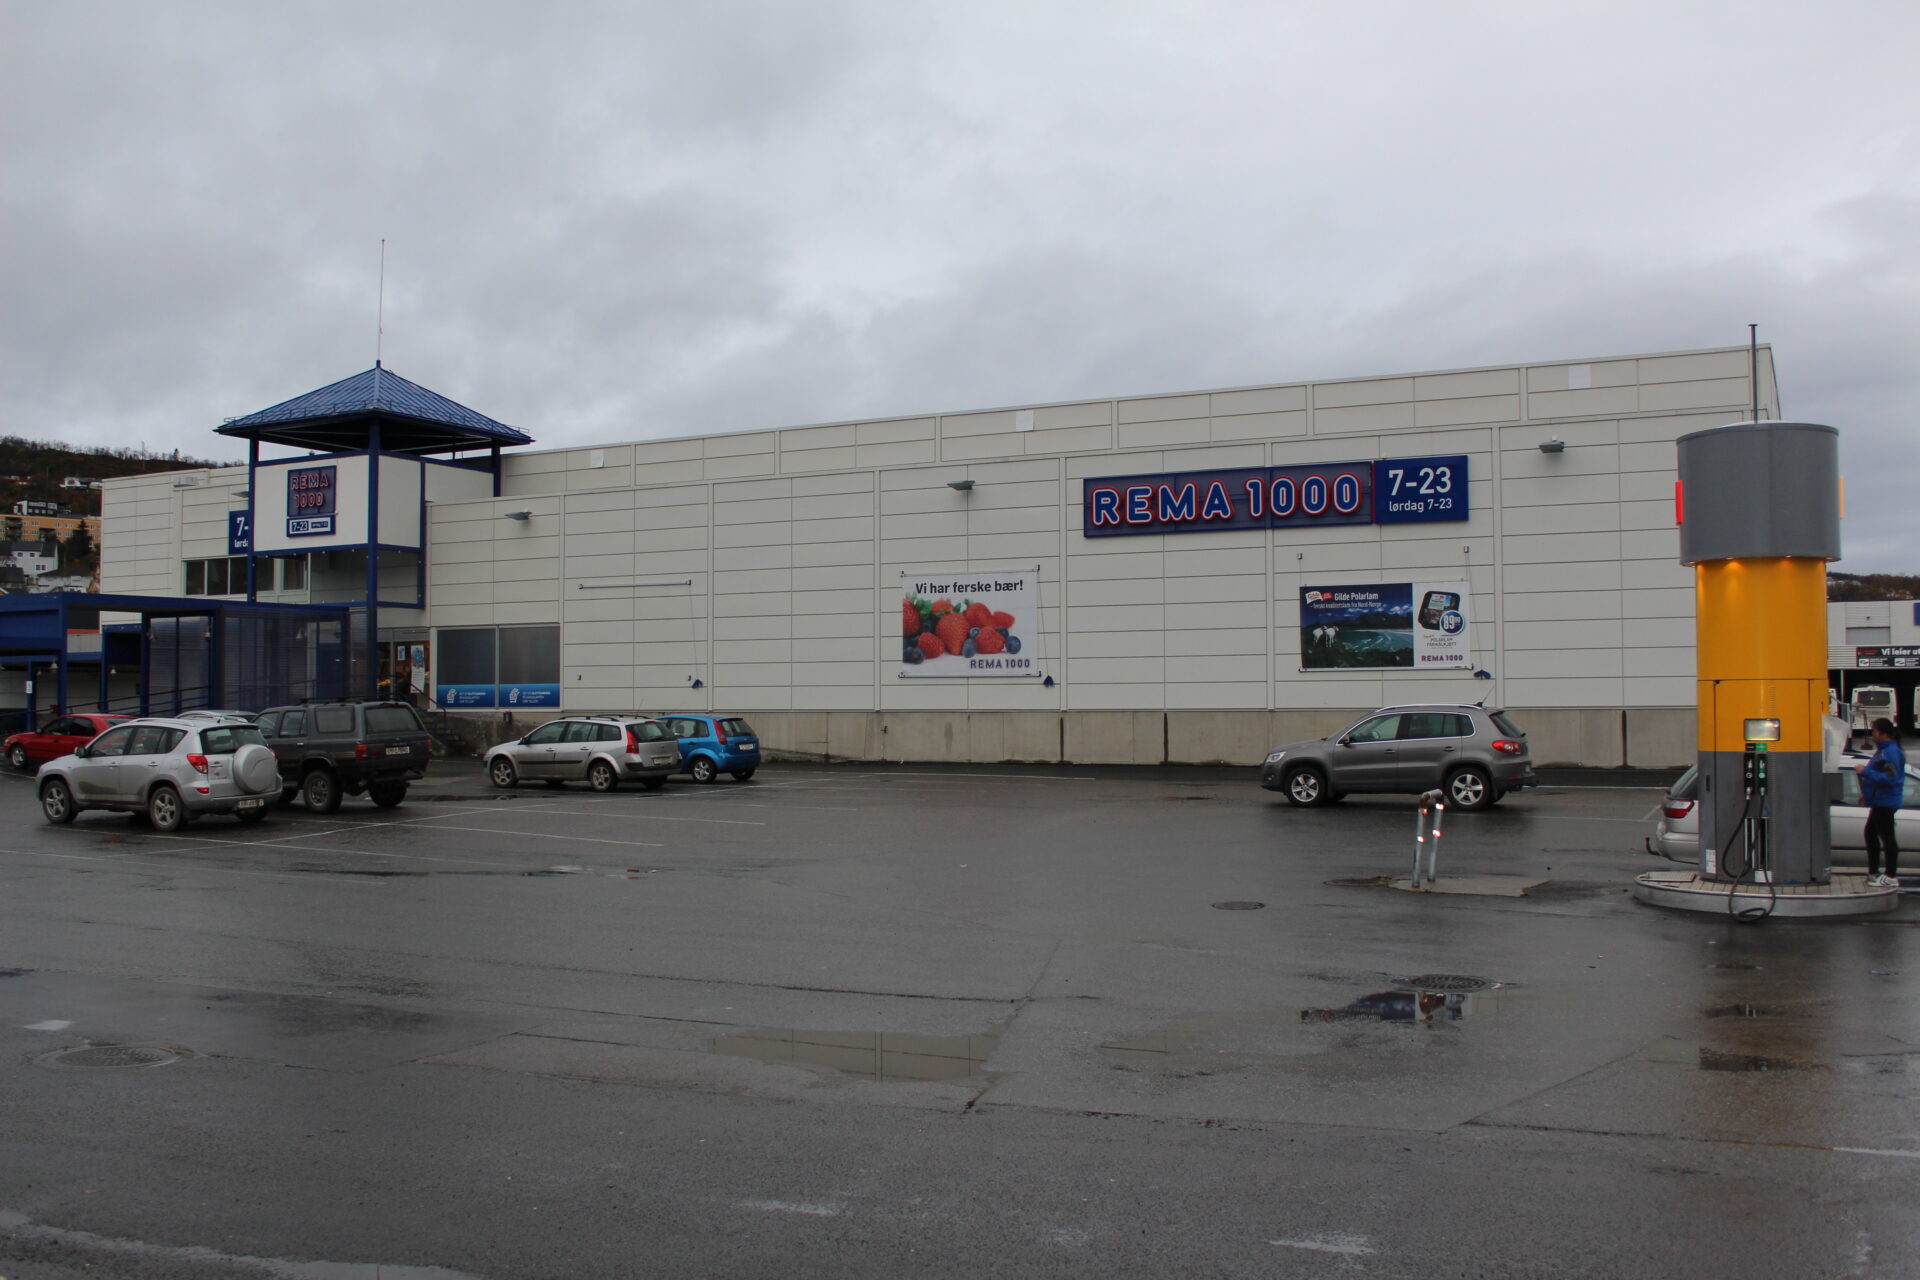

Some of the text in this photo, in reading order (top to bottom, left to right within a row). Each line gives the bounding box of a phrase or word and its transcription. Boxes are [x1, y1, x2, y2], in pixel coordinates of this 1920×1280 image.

[290, 474, 329, 490] REMA
[1388, 467, 1452, 496] 7-23
[295, 492, 323, 508] 1000
[1091, 473, 1362, 527] REMA 1000
[1389, 498, 1453, 513] lørdag 7-23
[293, 522, 307, 532] 7-23
[915, 579, 1023, 594] Vi har ferske bær!
[1351, 592, 1379, 600] Polarlam
[970, 658, 1030, 669] REMA 1000
